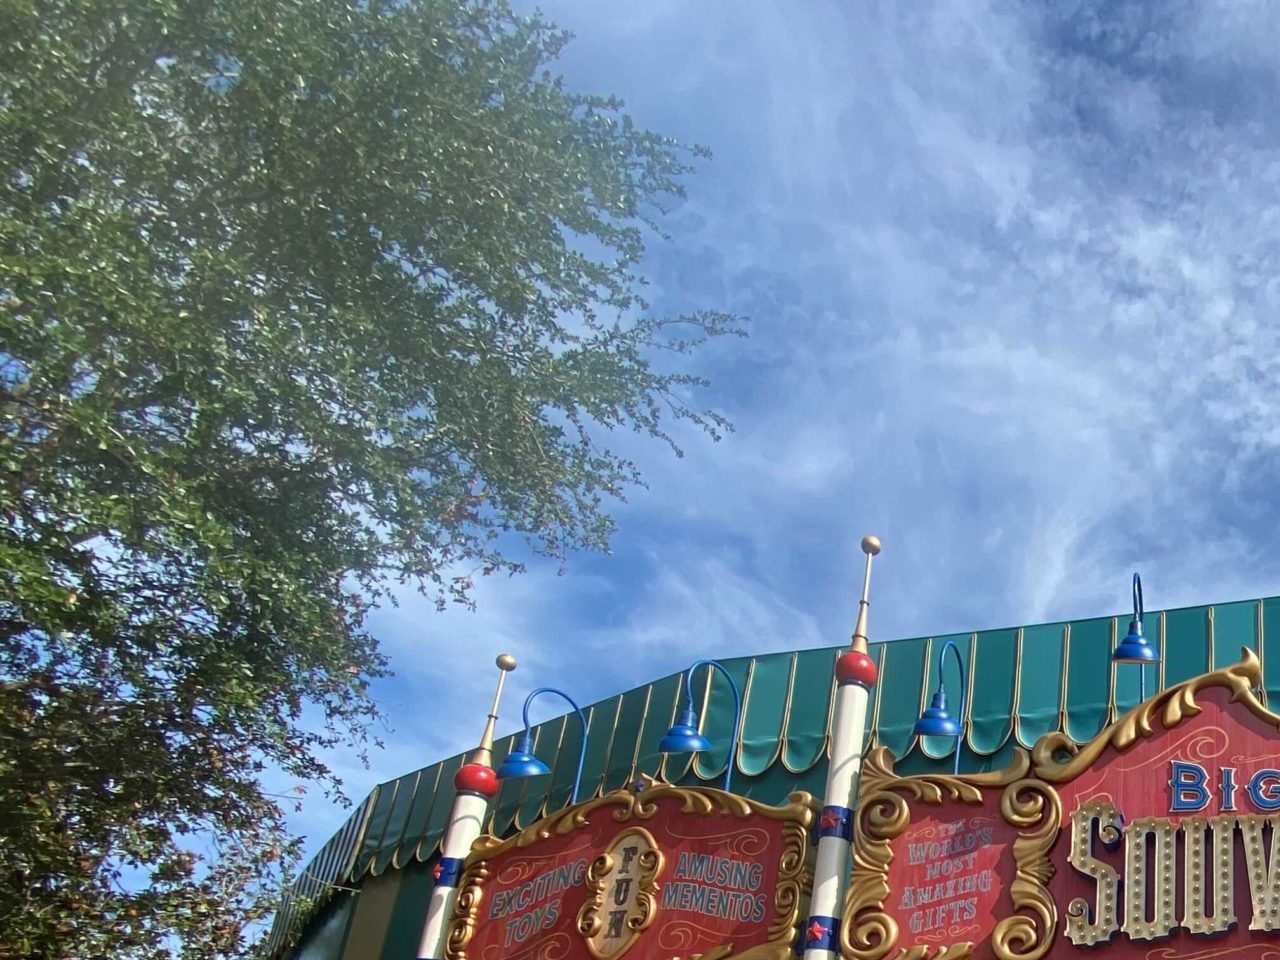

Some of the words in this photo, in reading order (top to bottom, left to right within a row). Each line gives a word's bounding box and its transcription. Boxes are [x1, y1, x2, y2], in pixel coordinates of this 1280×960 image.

[908, 827, 993, 865] WORLD'S
[938, 819, 966, 837] THE
[674, 851, 763, 891] AMUSING
[925, 852, 977, 880] MOST
[488, 858, 588, 921] EXCITING
[604, 847, 639, 940] FUN
[662, 882, 766, 922] MEMENTOS
[898, 870, 992, 910] AMAZING
[503, 900, 560, 947] TOYS
[909, 897, 977, 933] GIFTS
